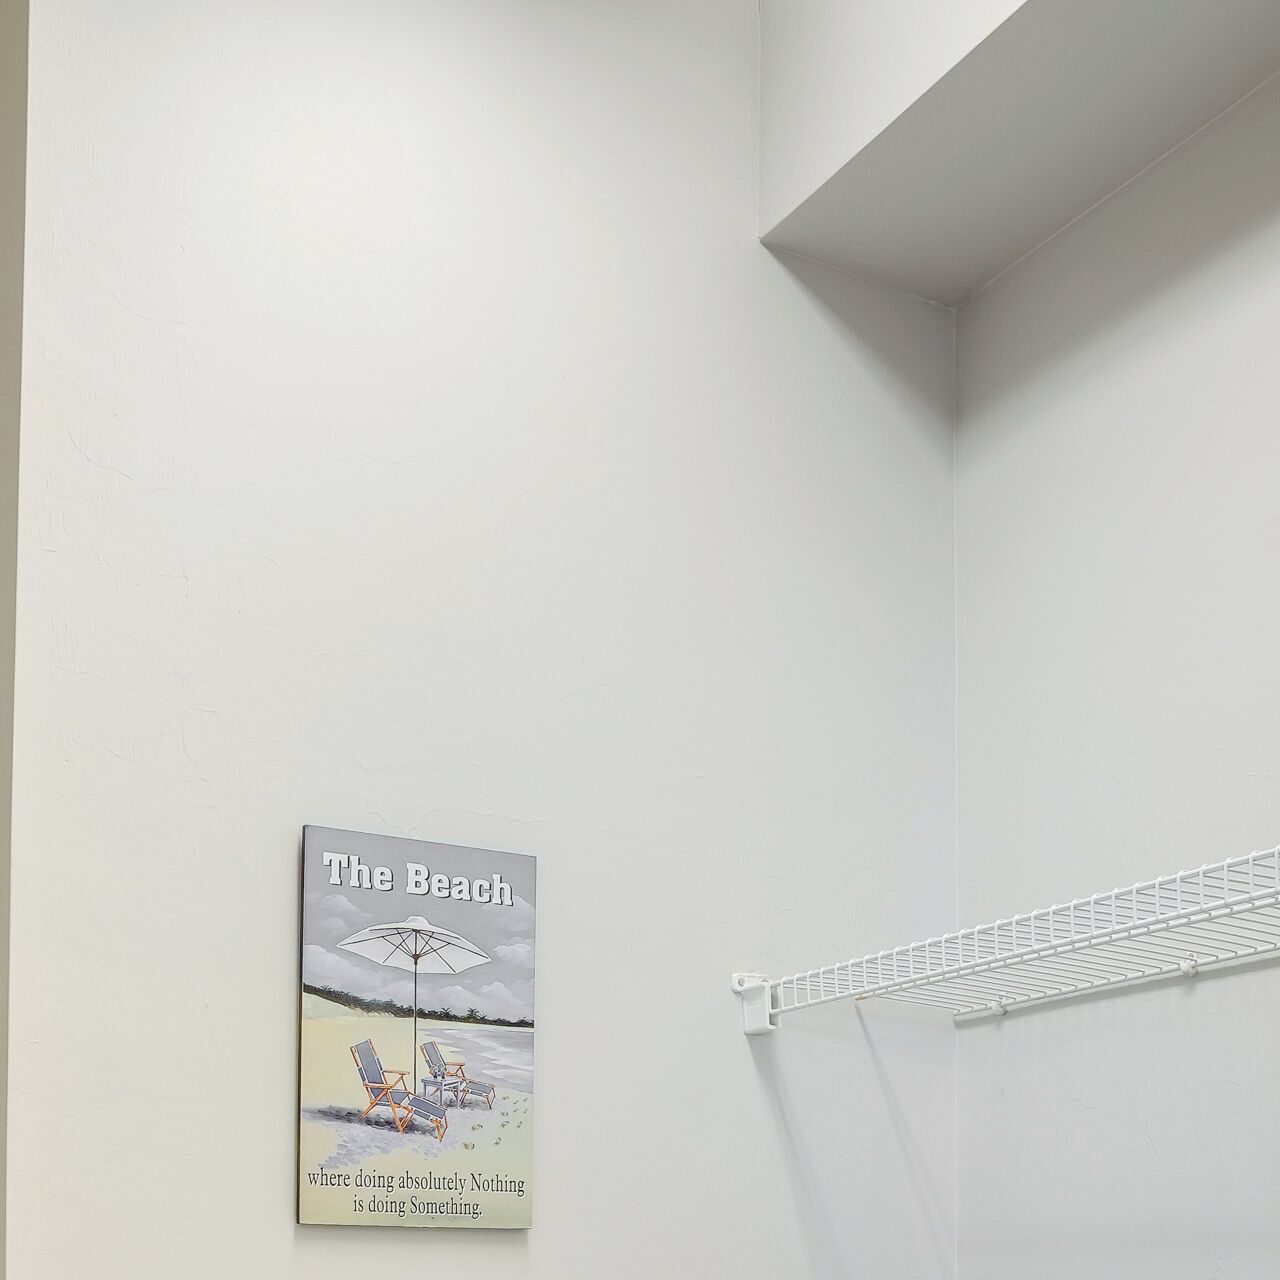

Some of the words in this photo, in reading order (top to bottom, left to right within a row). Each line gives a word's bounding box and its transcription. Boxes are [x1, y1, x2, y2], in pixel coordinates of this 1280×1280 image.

[323, 852, 393, 891] The
[406, 863, 513, 906] Beach
[308, 1168, 351, 1187] where
[355, 1169, 395, 1193] doing
[398, 1171, 467, 1195] absolutely
[470, 1173, 525, 1196] Nothing
[353, 1194, 364, 1212] is
[368, 1195, 406, 1217] doing
[410, 1196, 483, 1219] Something.
